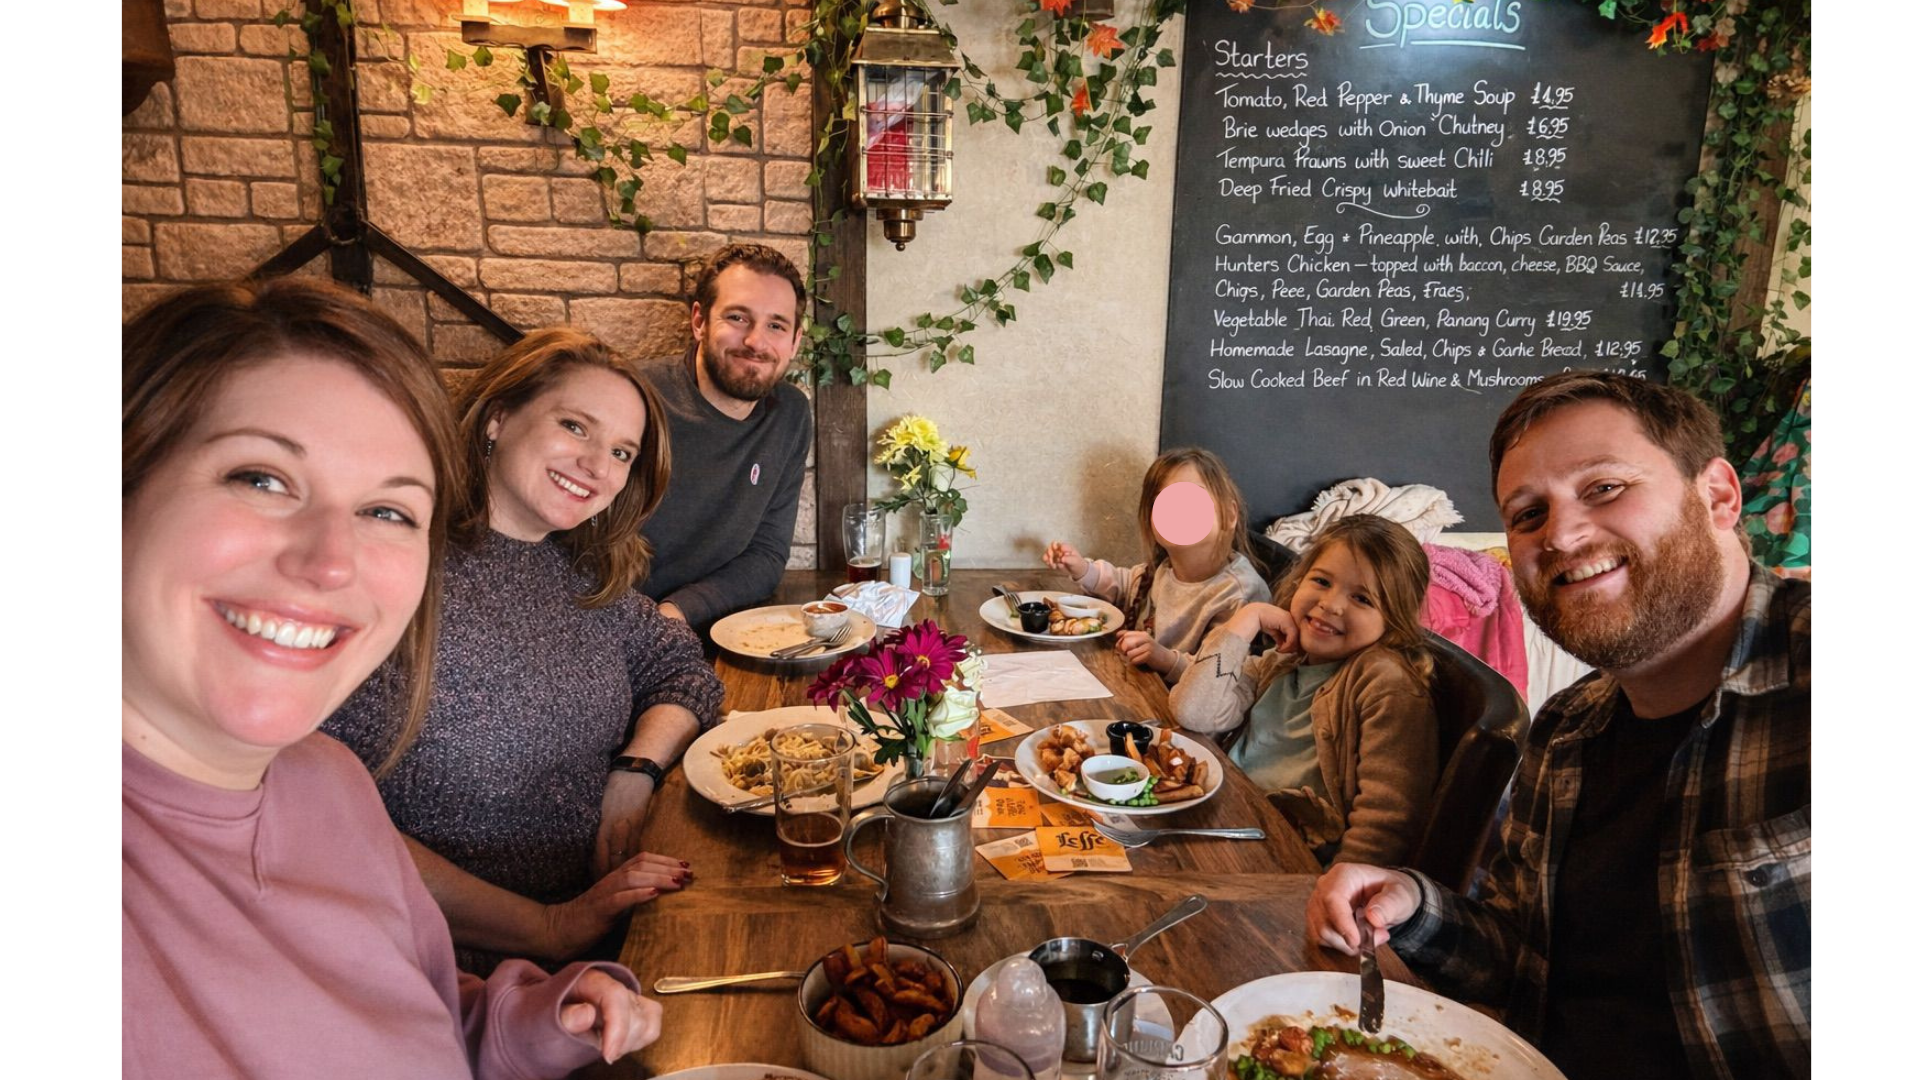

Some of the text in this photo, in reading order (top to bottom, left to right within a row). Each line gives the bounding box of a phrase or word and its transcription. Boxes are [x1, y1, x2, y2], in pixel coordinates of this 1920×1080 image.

[1364, 0, 1522, 48] Specials
[1214, 39, 1308, 70] Starters
[1214, 82, 1288, 110] Tomato,
[1292, 83, 1328, 108] Red
[1336, 80, 1393, 114] Pepper
[1399, 93, 1412, 105] &
[1413, 82, 1465, 118] Thyme
[1473, 79, 1516, 115] Soup
[1222, 115, 1259, 139] Brie
[1266, 119, 1328, 147] wedges
[1338, 118, 1373, 138] with
[1378, 119, 1426, 138] Onion
[1526, 116, 1571, 136] £6.95
[1216, 146, 1286, 174] Tempura
[1293, 146, 1347, 169] Prawns
[1354, 147, 1390, 169] with
[1397, 148, 1447, 169] sweet
[1522, 147, 1568, 168] £8.95
[1218, 177, 1263, 204] Deep
[1269, 174, 1312, 197] Fried
[1321, 176, 1372, 206] Crispy
[1519, 178, 1565, 198] £8.95
[1214, 223, 1298, 247] Gammon,
[1303, 224, 1335, 255] Egg
[1489, 225, 1532, 253] Chips
[1597, 222, 1628, 247] Peas
[1214, 253, 1280, 273] Hunters
[1287, 253, 1351, 273] Chicken
[1423, 253, 1454, 273] with
[1511, 253, 1561, 275] cheese,
[1565, 255, 1598, 275] BBQ
[1602, 255, 1645, 276] Sauce,
[1316, 278, 1371, 299] Garden
[1376, 278, 1417, 302] Peas,
[1213, 306, 1288, 337] Vegetable
[1379, 307, 1430, 330] Green,
[1435, 308, 1490, 337] Panang
[1495, 309, 1536, 337] Curry
[1545, 309, 1594, 328] £19.95
[1210, 338, 1295, 357] Homemade
[1304, 336, 1375, 365] Lasagne,
[1431, 338, 1472, 364] Chips
[1207, 368, 1245, 390] Slow
[1250, 368, 1305, 388] Cooked
[1312, 367, 1351, 388] Beef
[1356, 371, 1372, 388] in
[1376, 367, 1407, 388] Red
[1411, 370, 1447, 388] Wine
[1450, 373, 1462, 387] &
[1055, 831, 1108, 851] Leffe
